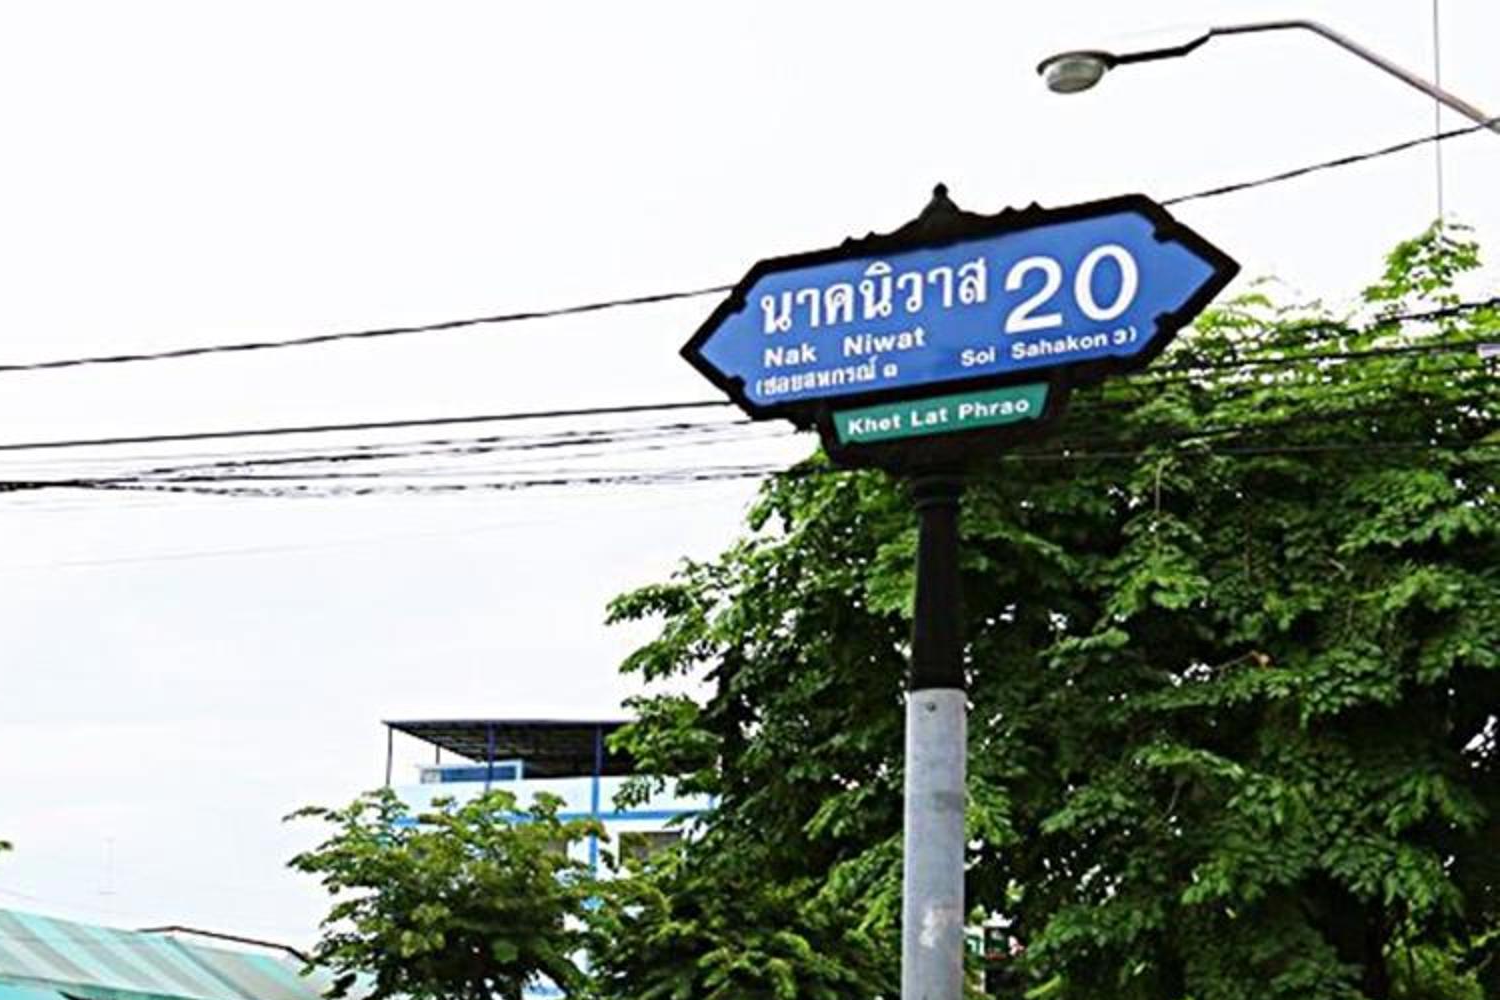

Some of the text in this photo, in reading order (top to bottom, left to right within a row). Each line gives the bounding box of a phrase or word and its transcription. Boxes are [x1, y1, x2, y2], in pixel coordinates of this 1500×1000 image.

[760, 244, 1139, 335] นาคนิวาส 20
[764, 327, 927, 368] Nak Niwat
[960, 346, 996, 367] Soi
[1011, 332, 1108, 360] Sahakon
[848, 398, 1030, 436] Khet Lat Phrao
